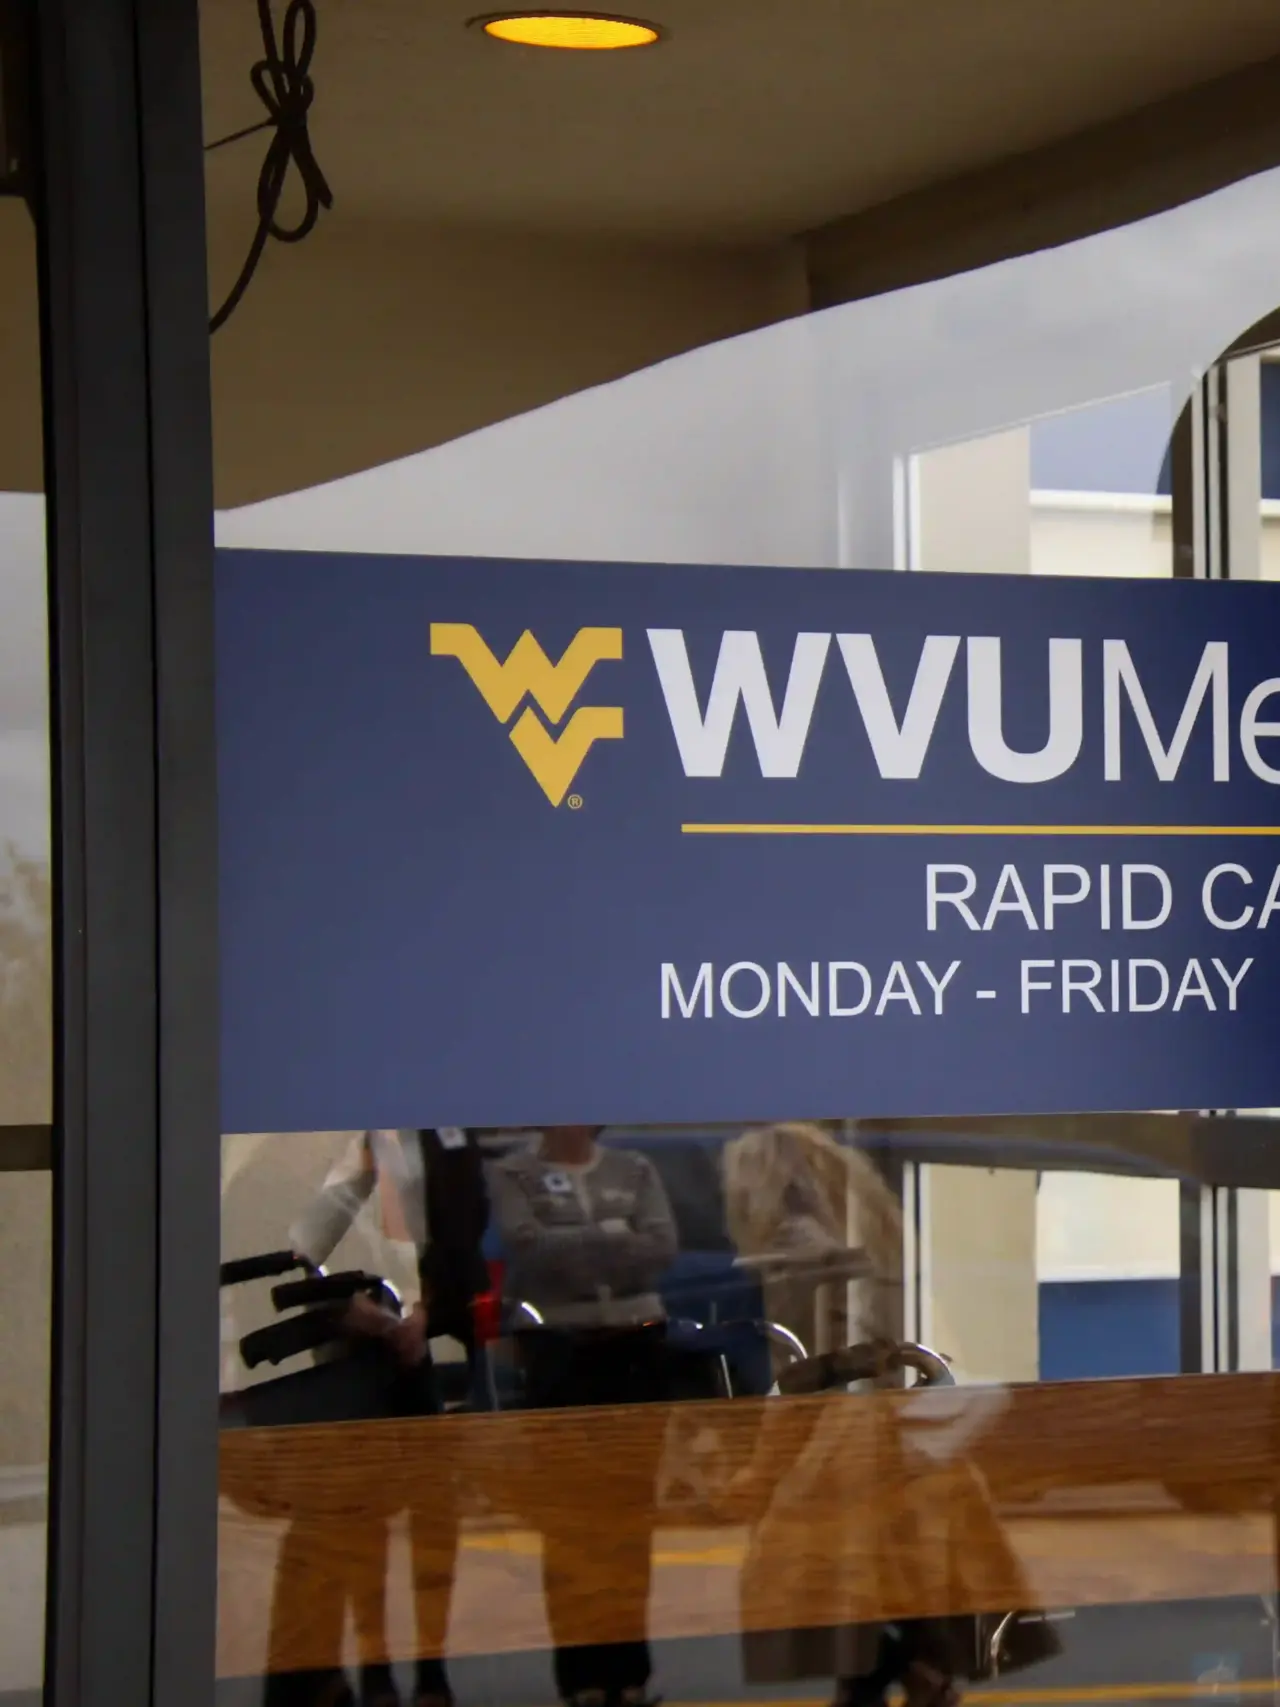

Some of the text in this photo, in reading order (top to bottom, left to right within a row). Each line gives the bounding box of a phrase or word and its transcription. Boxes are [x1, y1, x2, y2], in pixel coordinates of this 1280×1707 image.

[926, 863, 1173, 931] RAPID
[660, 960, 962, 1019] MONDAY
[1019, 958, 1255, 1014] FRIDAY
